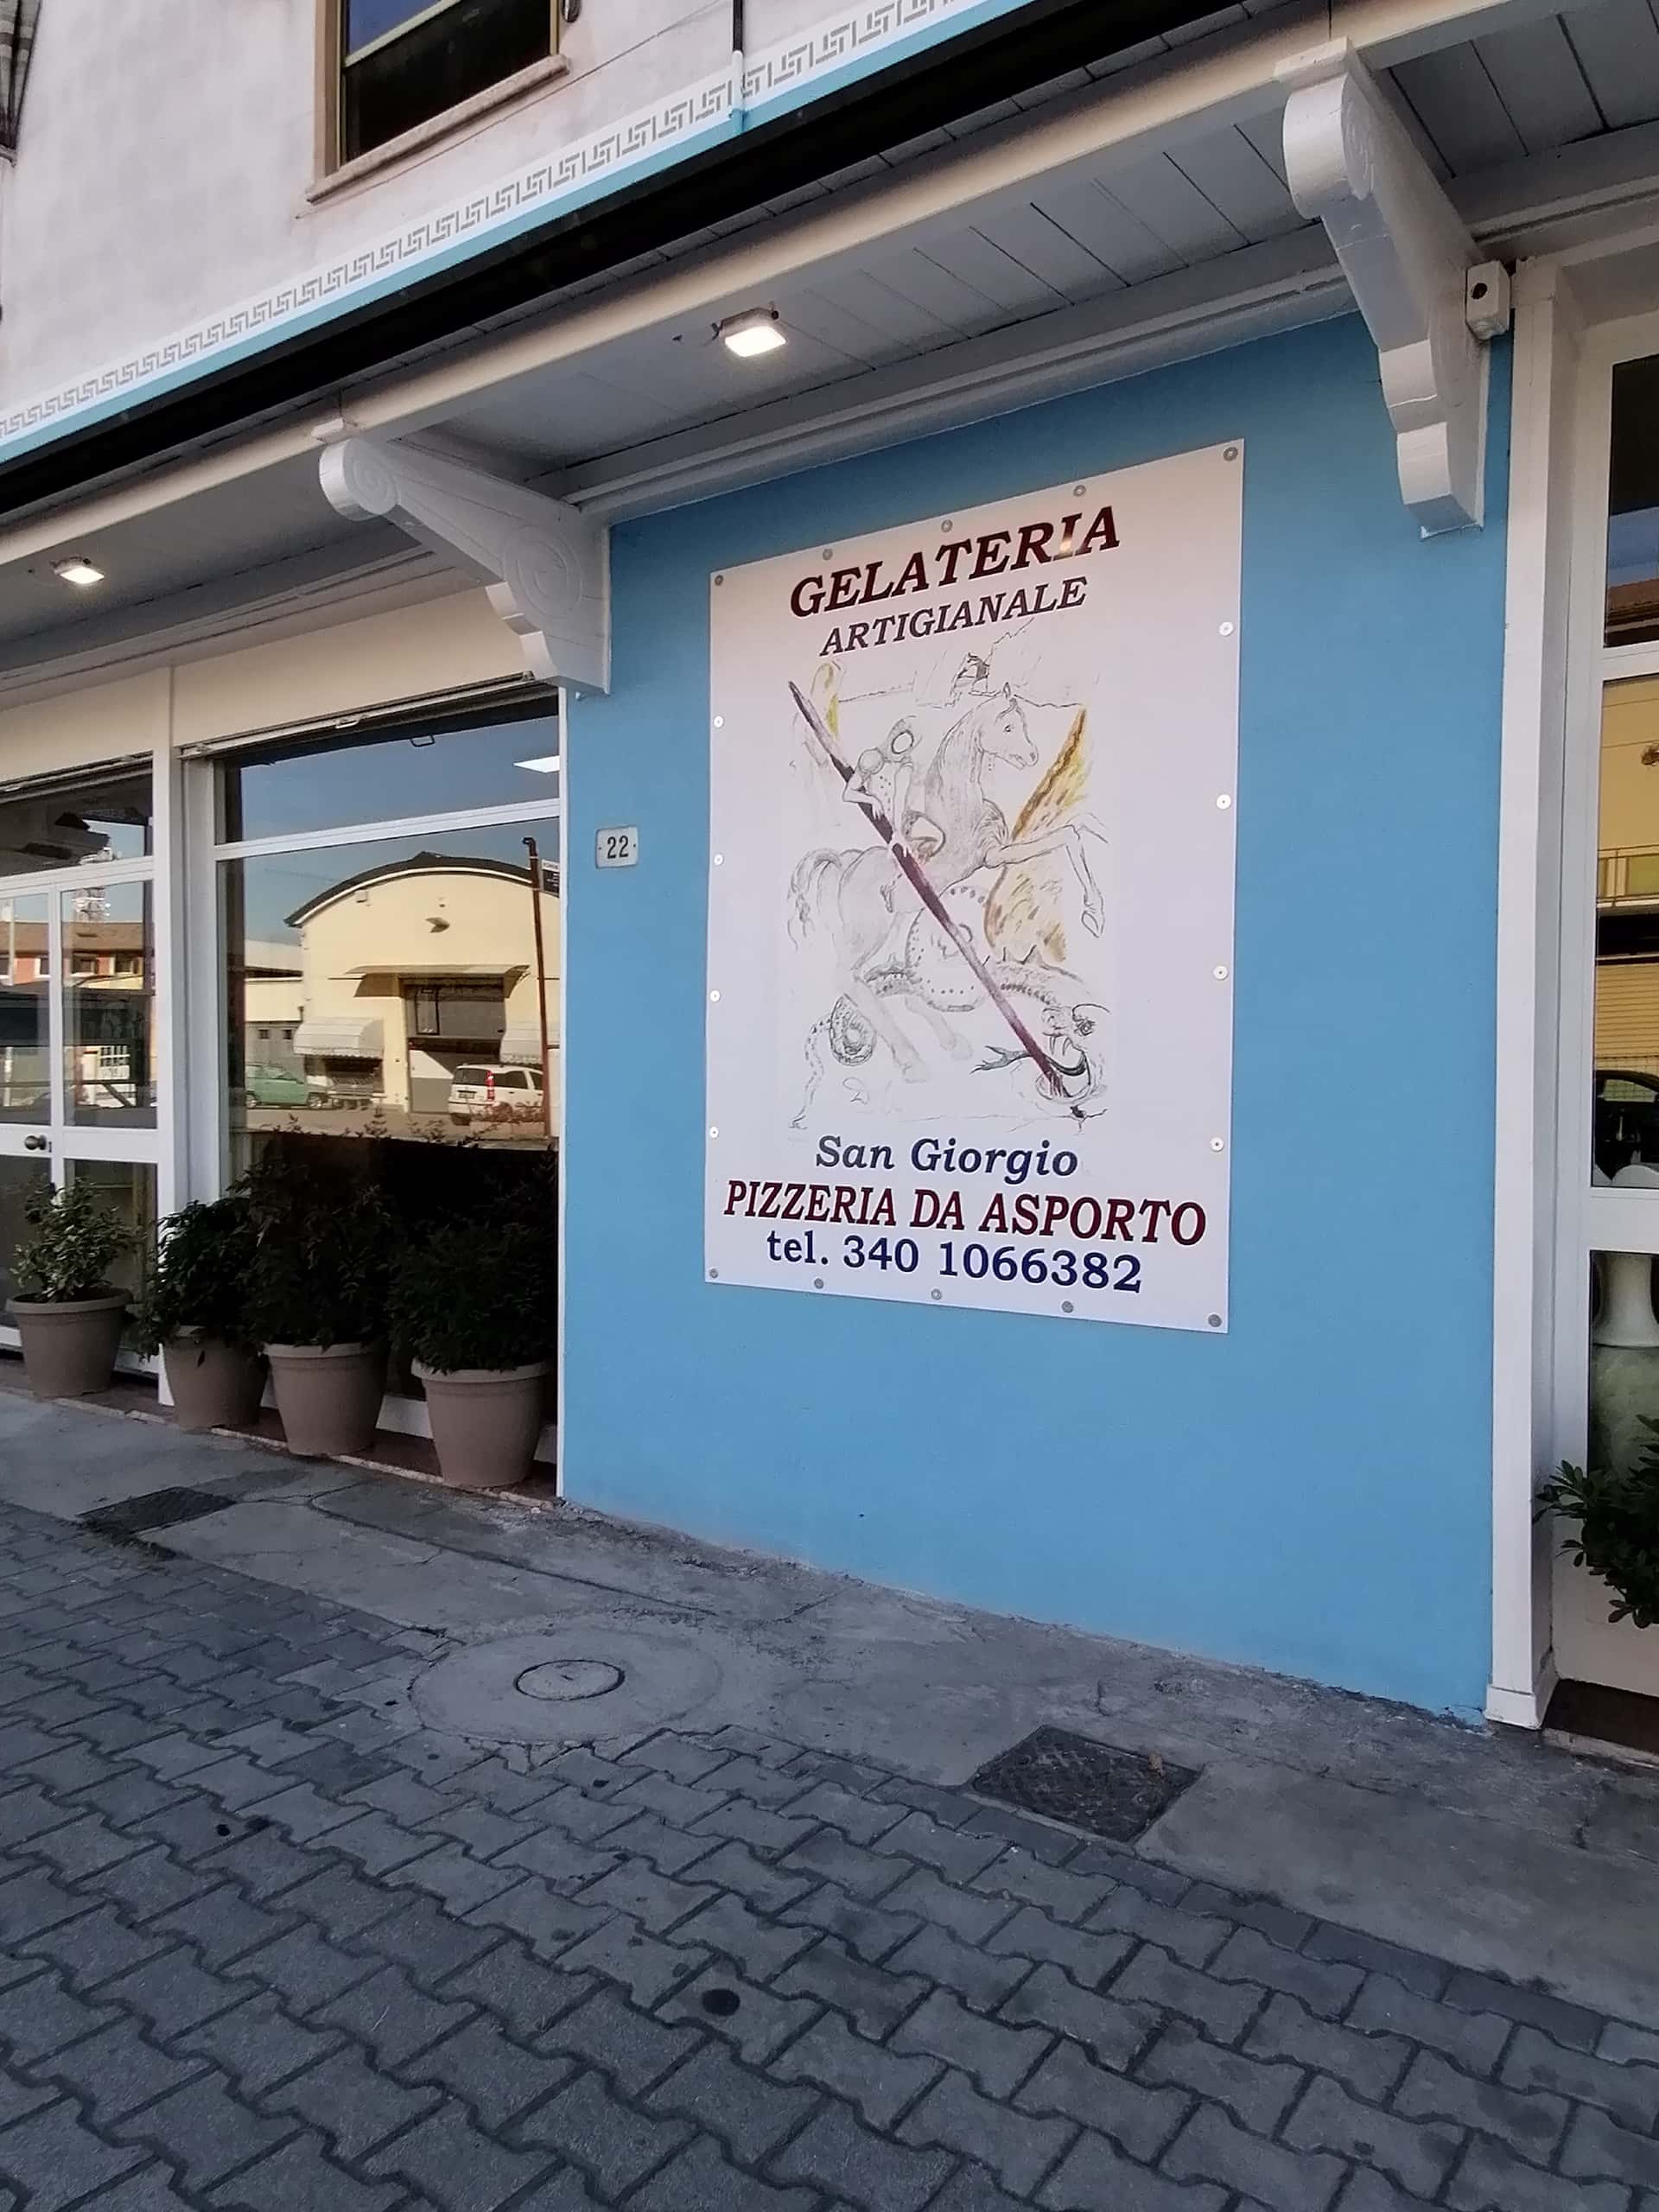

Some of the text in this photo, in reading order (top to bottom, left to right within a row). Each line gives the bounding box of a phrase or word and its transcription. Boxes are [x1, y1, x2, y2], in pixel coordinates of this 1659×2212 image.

[790, 505, 1120, 617] GELATERIA
[819, 576, 1087, 656] ARTIGIANALE
[607, 835, 629, 860] 22
[816, 1135, 1078, 1185] San Giorgio
[723, 1180, 1207, 1246] PIZZERIA DA ASPORTO
[766, 1230, 1142, 1294] tel. 340 1066382
